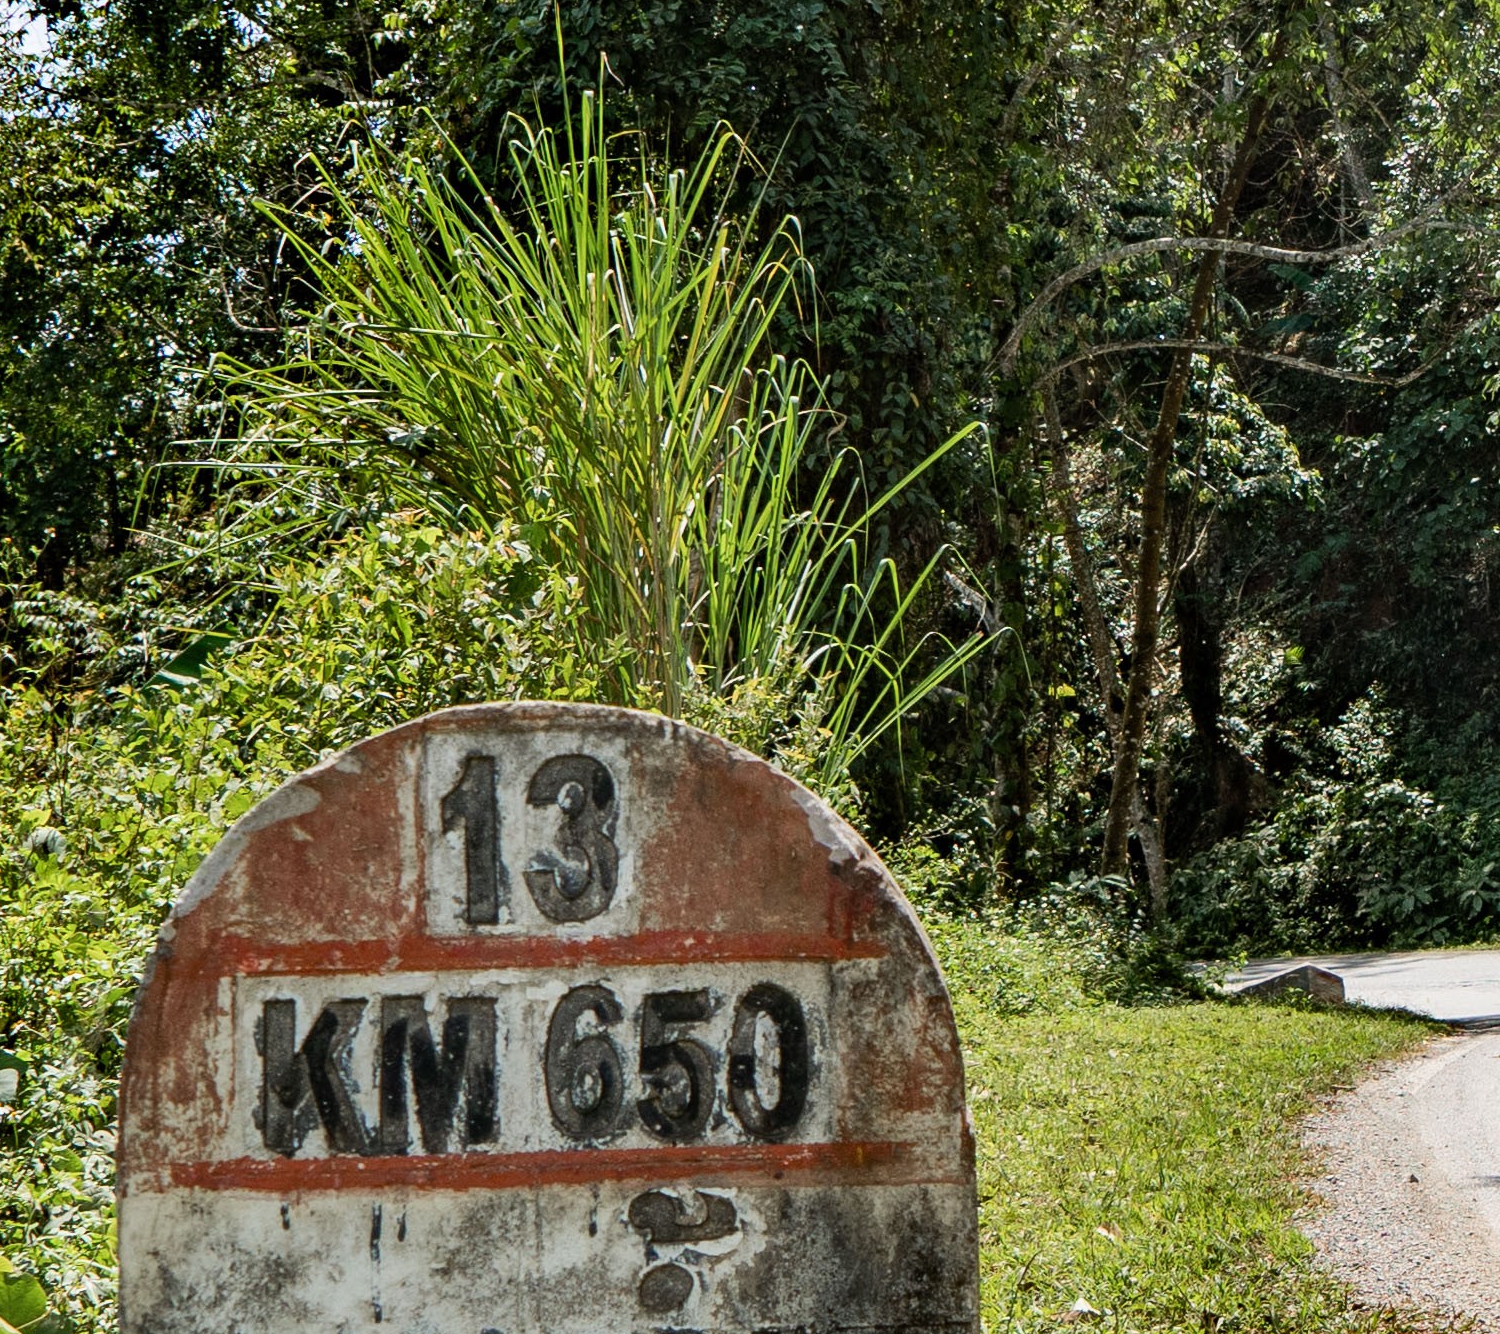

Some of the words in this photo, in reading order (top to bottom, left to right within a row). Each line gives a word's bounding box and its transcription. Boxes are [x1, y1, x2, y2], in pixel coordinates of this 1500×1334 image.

[441, 753, 620, 925] 13
[257, 997, 499, 1155] KM
[543, 982, 809, 1141] 650
